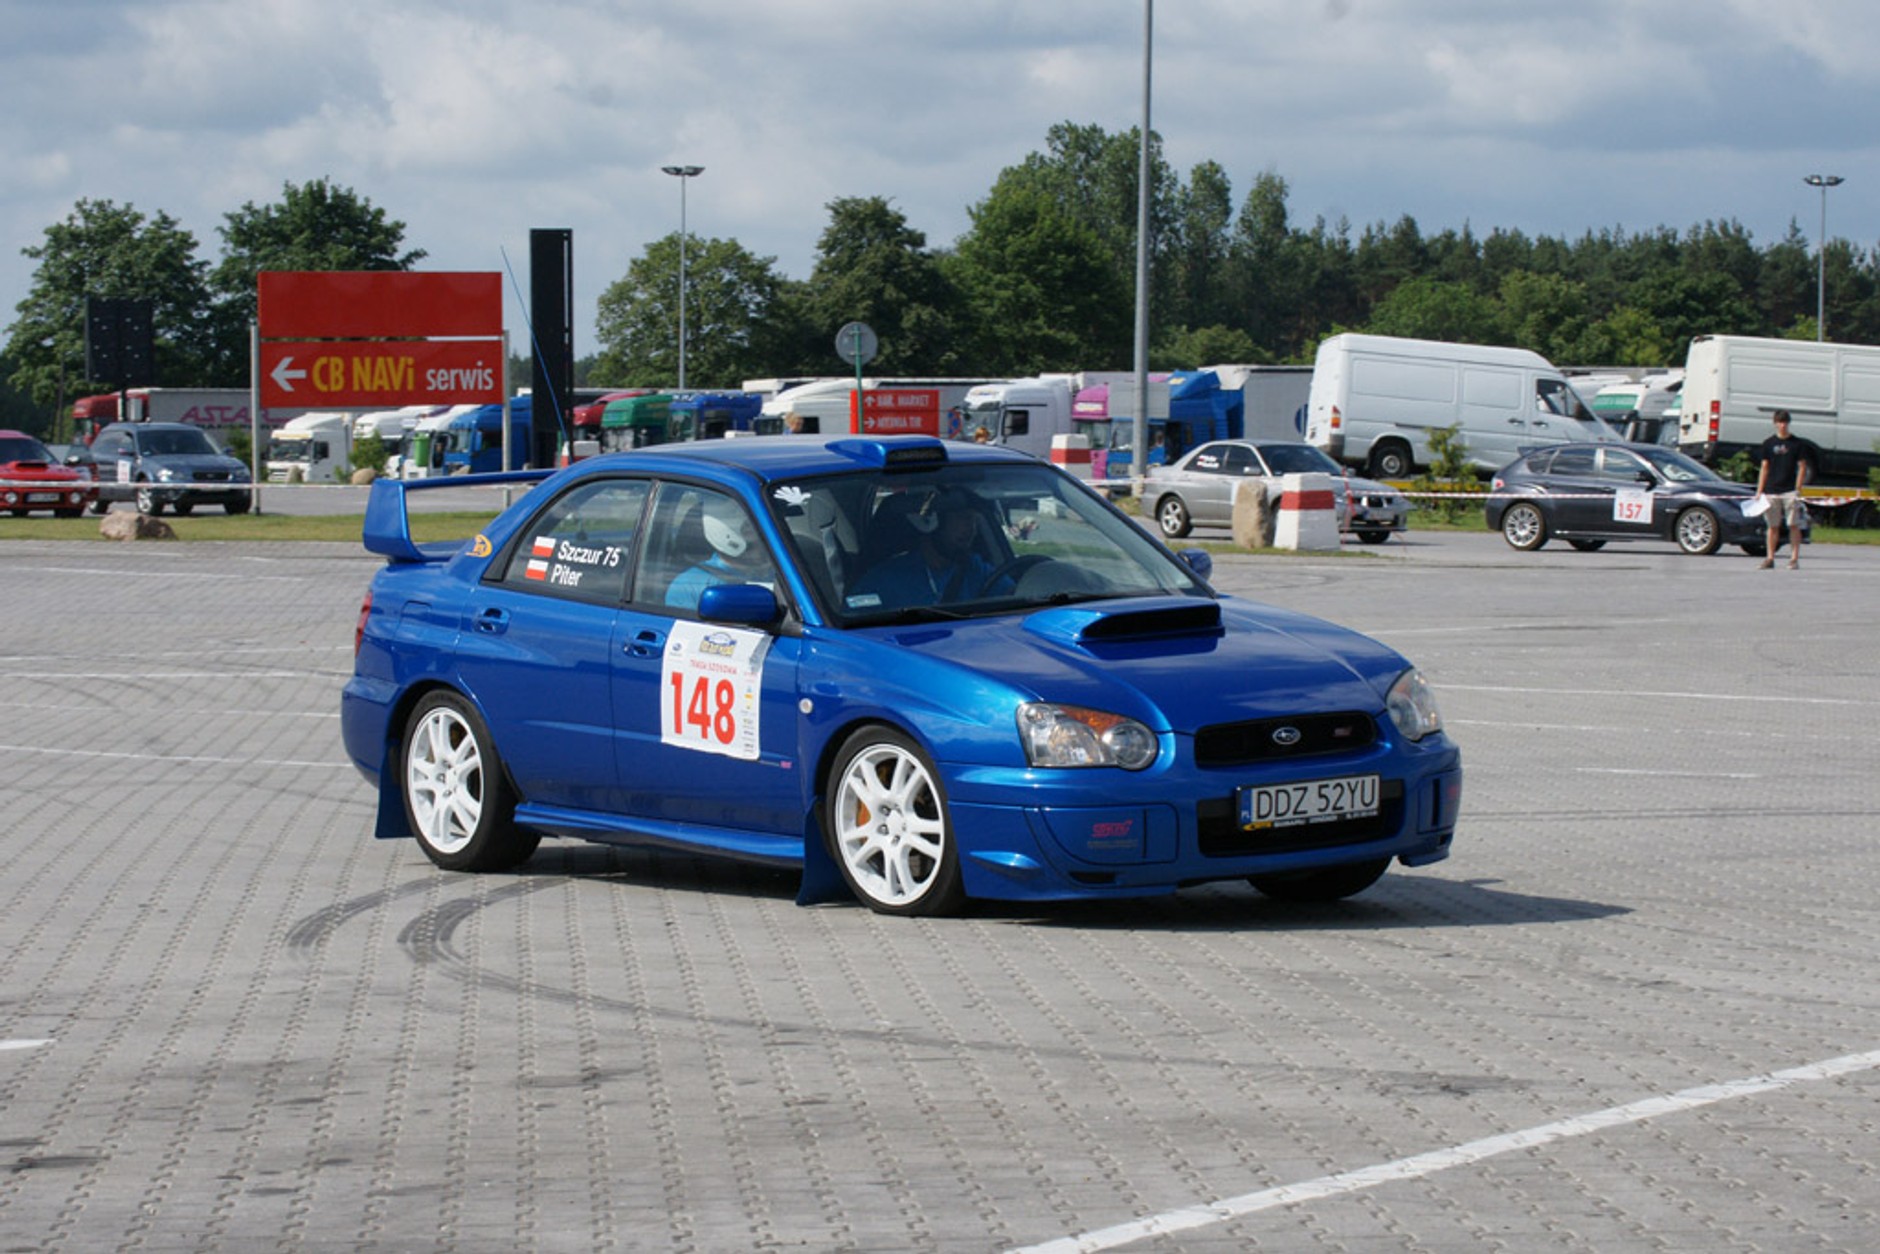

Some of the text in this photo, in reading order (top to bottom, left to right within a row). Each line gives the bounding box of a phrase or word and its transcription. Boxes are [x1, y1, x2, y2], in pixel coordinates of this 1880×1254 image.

[312, 356, 494, 392] CB NAVi serwis
[1618, 502, 1643, 519] 157
[558, 540, 621, 567] Szczur 75
[550, 563, 583, 587] Piter
[671, 671, 736, 745] 148
[1256, 778, 1377, 820] DDZ 52YU
